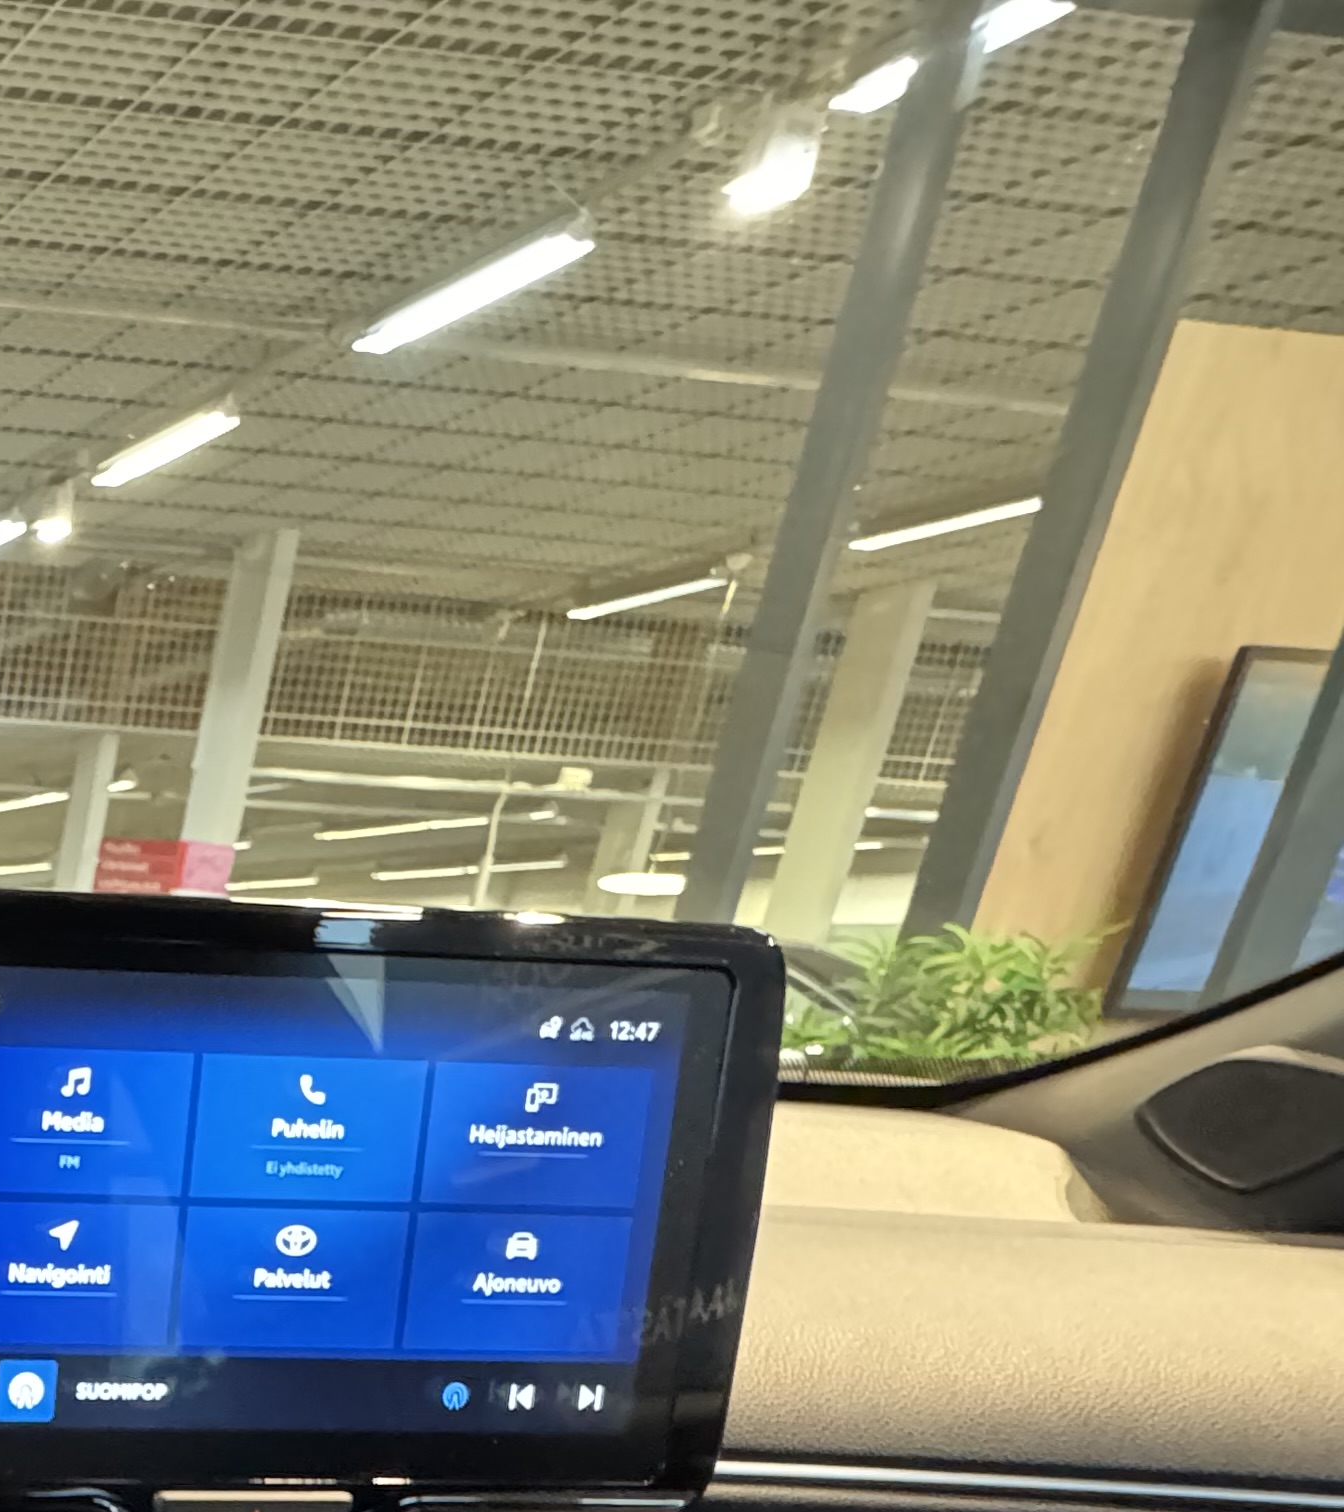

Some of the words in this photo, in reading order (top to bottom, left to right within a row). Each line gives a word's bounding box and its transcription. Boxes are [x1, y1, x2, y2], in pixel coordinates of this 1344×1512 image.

[609, 1020, 661, 1043] 12:47
[41, 1110, 104, 1133] Media
[271, 1117, 344, 1140] Puhelin
[469, 1123, 604, 1148] Heijastaminen
[59, 1155, 81, 1169] FM
[266, 1160, 277, 1175] Ei
[279, 1161, 343, 1180] yhdistetty
[8, 1262, 112, 1288] Navigointi
[254, 1267, 332, 1290] Palvelut
[472, 1271, 562, 1297] Ajoneuvo
[76, 1381, 169, 1401] SUOMIPOP
